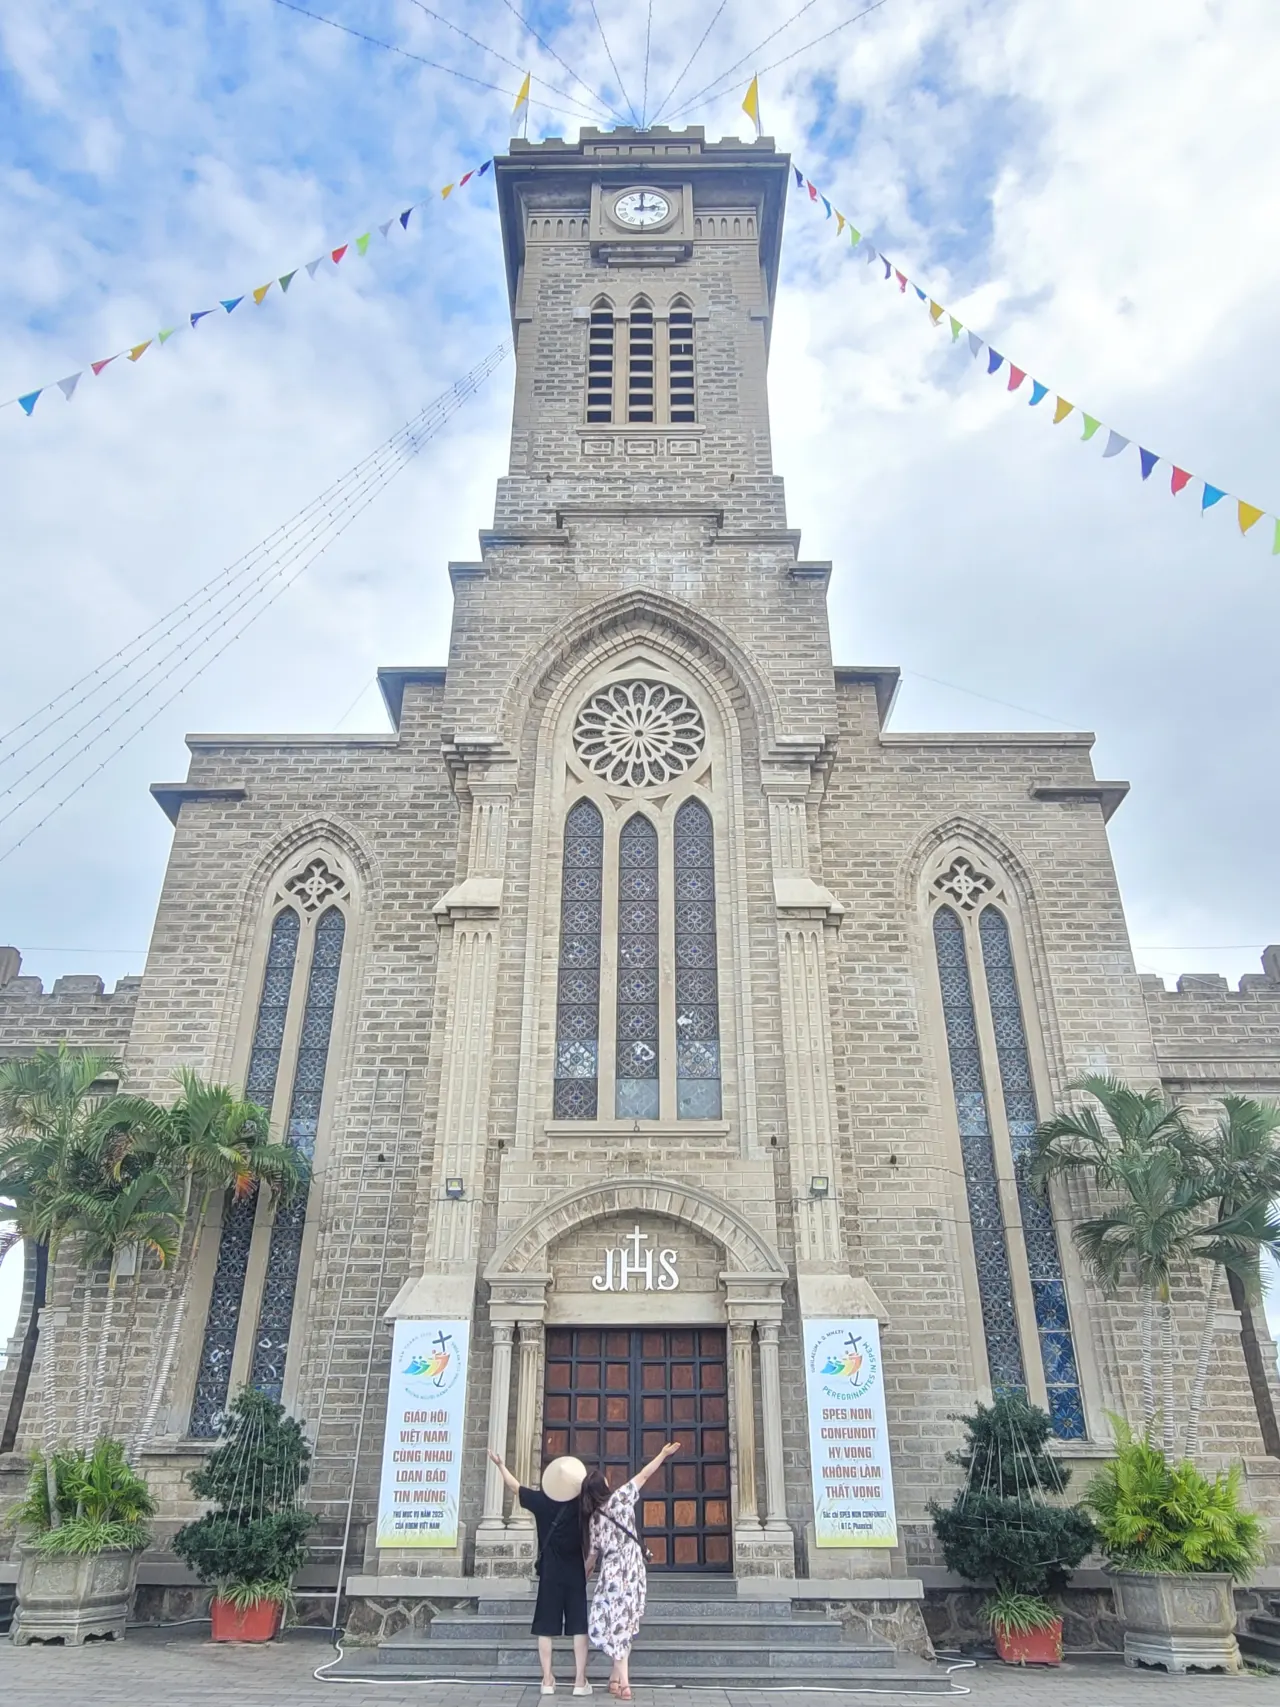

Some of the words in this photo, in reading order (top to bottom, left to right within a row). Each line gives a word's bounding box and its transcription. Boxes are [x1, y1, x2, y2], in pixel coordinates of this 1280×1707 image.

[862, 1341, 876, 1363] SPEM
[869, 1364, 877, 1373] IN
[822, 1374, 876, 1401] PEREGRINANTES
[403, 1409, 427, 1423] GIÁO
[430, 1408, 447, 1426] HỘI
[822, 1408, 847, 1420] SPES
[850, 1408, 872, 1420] NON
[400, 1428, 420, 1446] VIỆT
[423, 1430, 448, 1443] NAM
[821, 1427, 876, 1439] CONFUNDIT
[392, 1448, 421, 1463] CÙNG
[424, 1450, 452, 1463] NHAU
[828, 1446, 841, 1459] HY
[844, 1446, 872, 1462] VỌNG
[396, 1470, 422, 1482] LOAN
[426, 1468, 446, 1482] BÁO
[822, 1463, 857, 1478] KHÔNG
[860, 1463, 881, 1478] LÀM
[393, 1490, 411, 1503] TIN
[413, 1487, 446, 1503] MỪNG
[825, 1482, 850, 1498] THẤT
[852, 1485, 881, 1501] VỌNG
